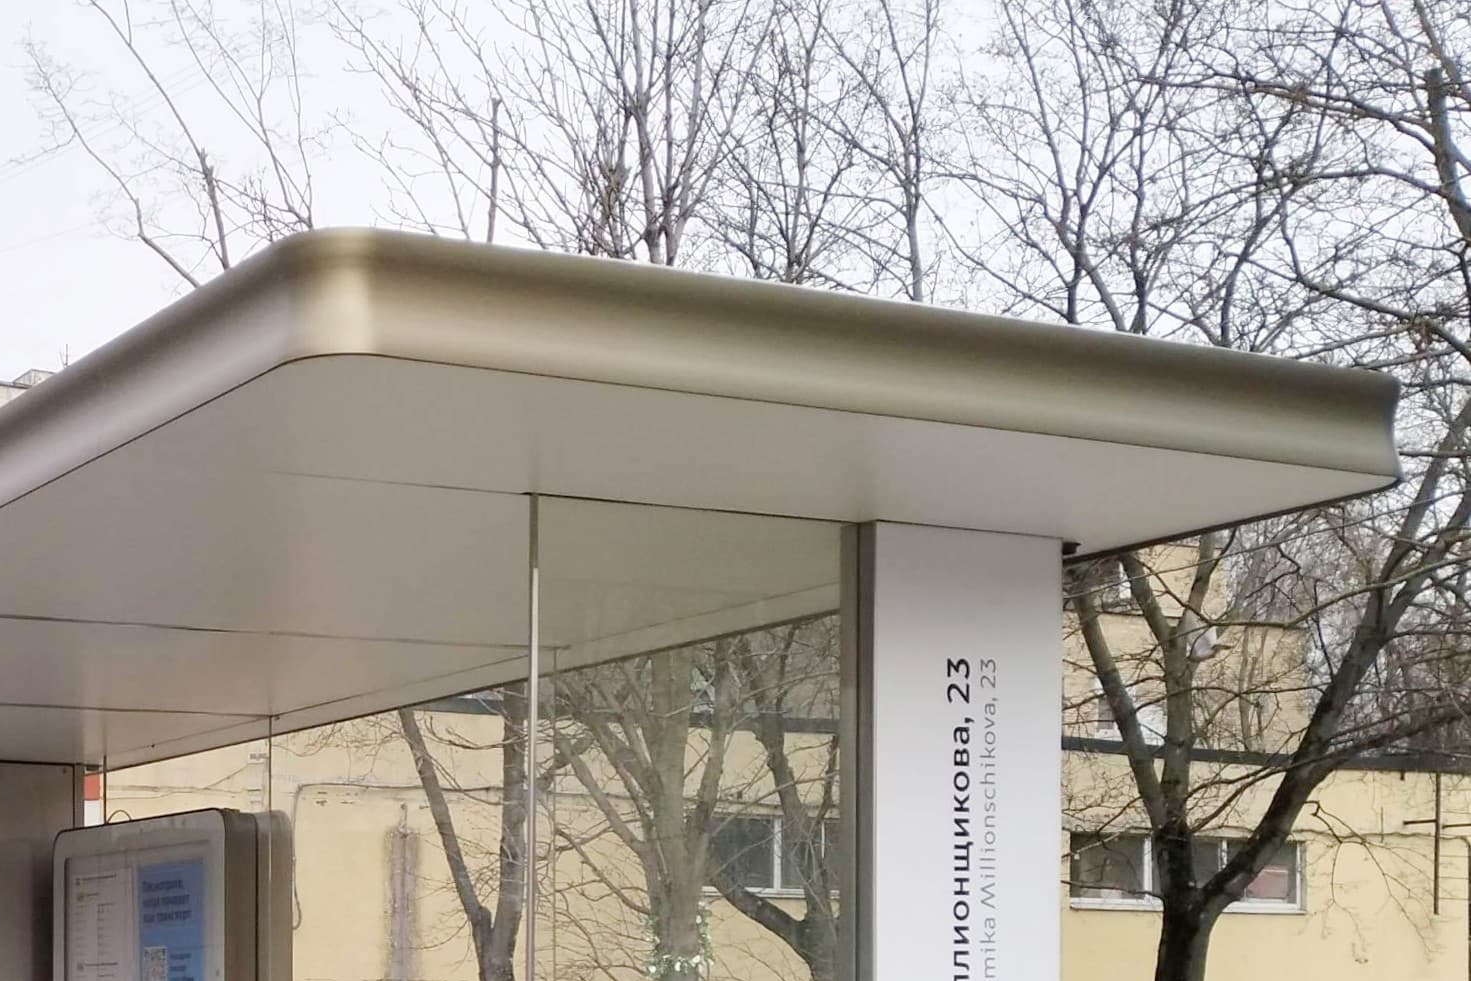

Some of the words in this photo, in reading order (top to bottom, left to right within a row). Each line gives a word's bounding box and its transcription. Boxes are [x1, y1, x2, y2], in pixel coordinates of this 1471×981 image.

[946, 657, 970, 704] 23
[980, 658, 997, 689] 23
[979, 697, 999, 909] Millionschikova,
